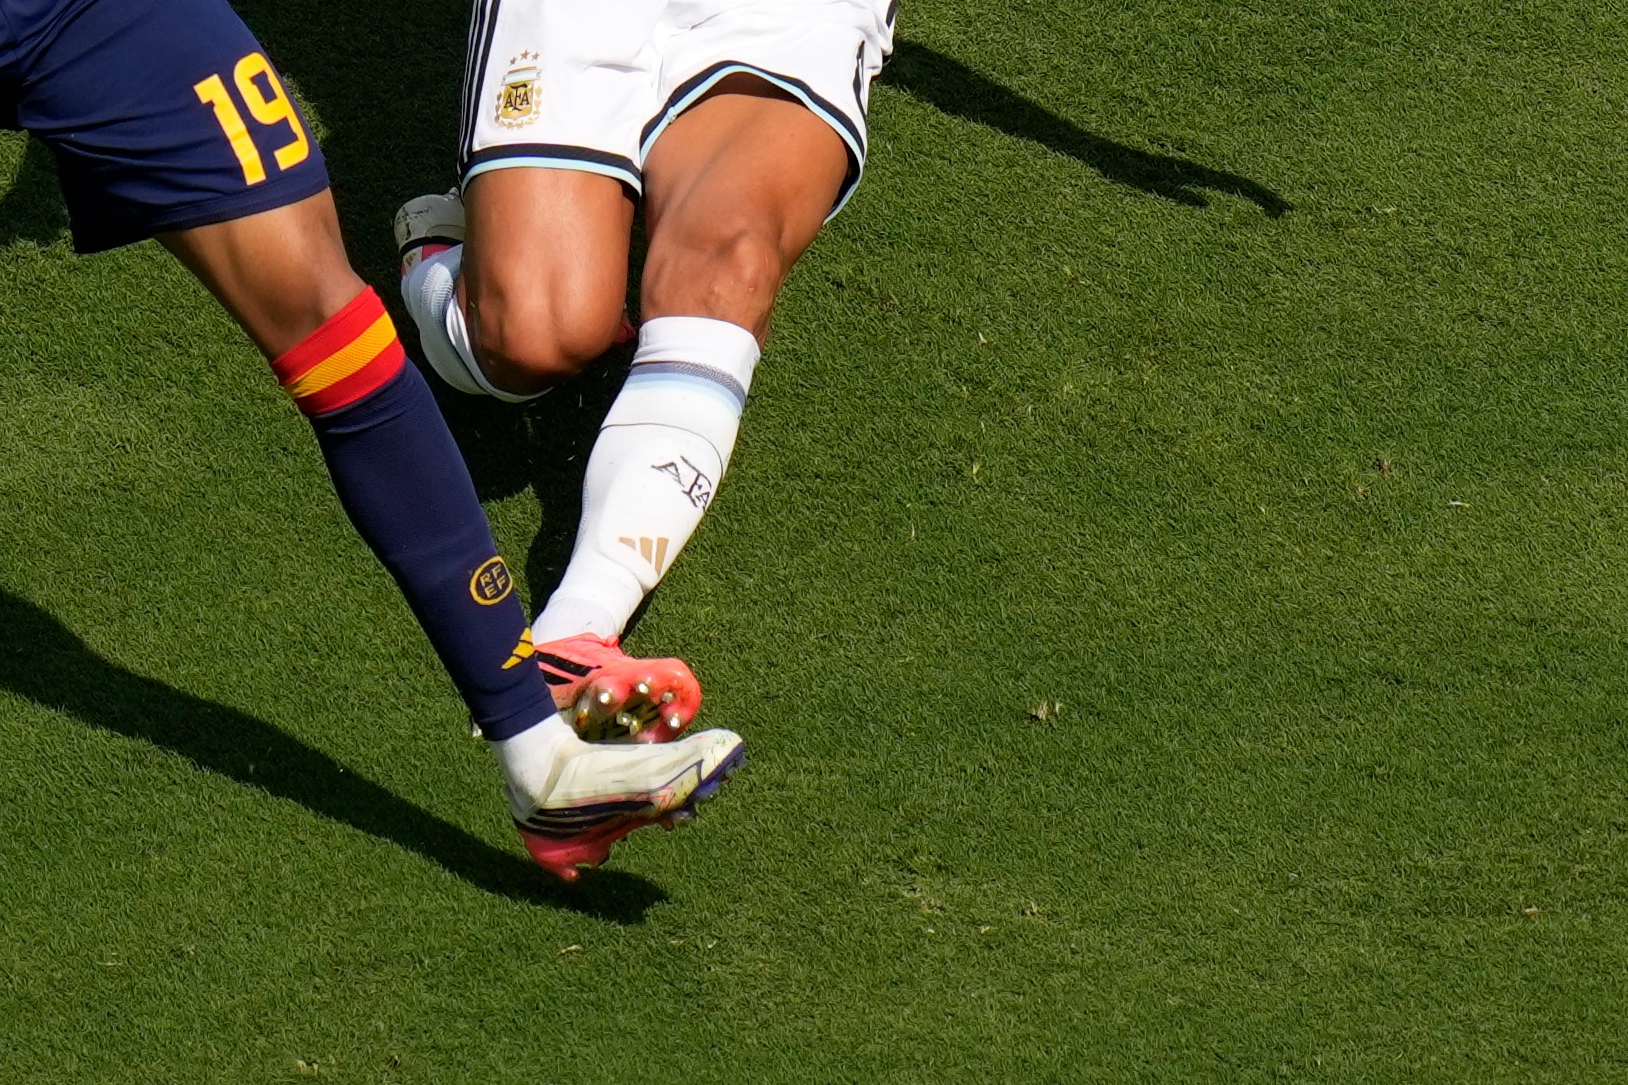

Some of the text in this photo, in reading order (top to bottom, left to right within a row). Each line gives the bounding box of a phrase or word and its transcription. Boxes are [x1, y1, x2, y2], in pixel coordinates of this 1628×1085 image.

[193, 51, 310, 186] 19
[503, 83, 530, 112] AFA
[651, 455, 712, 514] AFA
